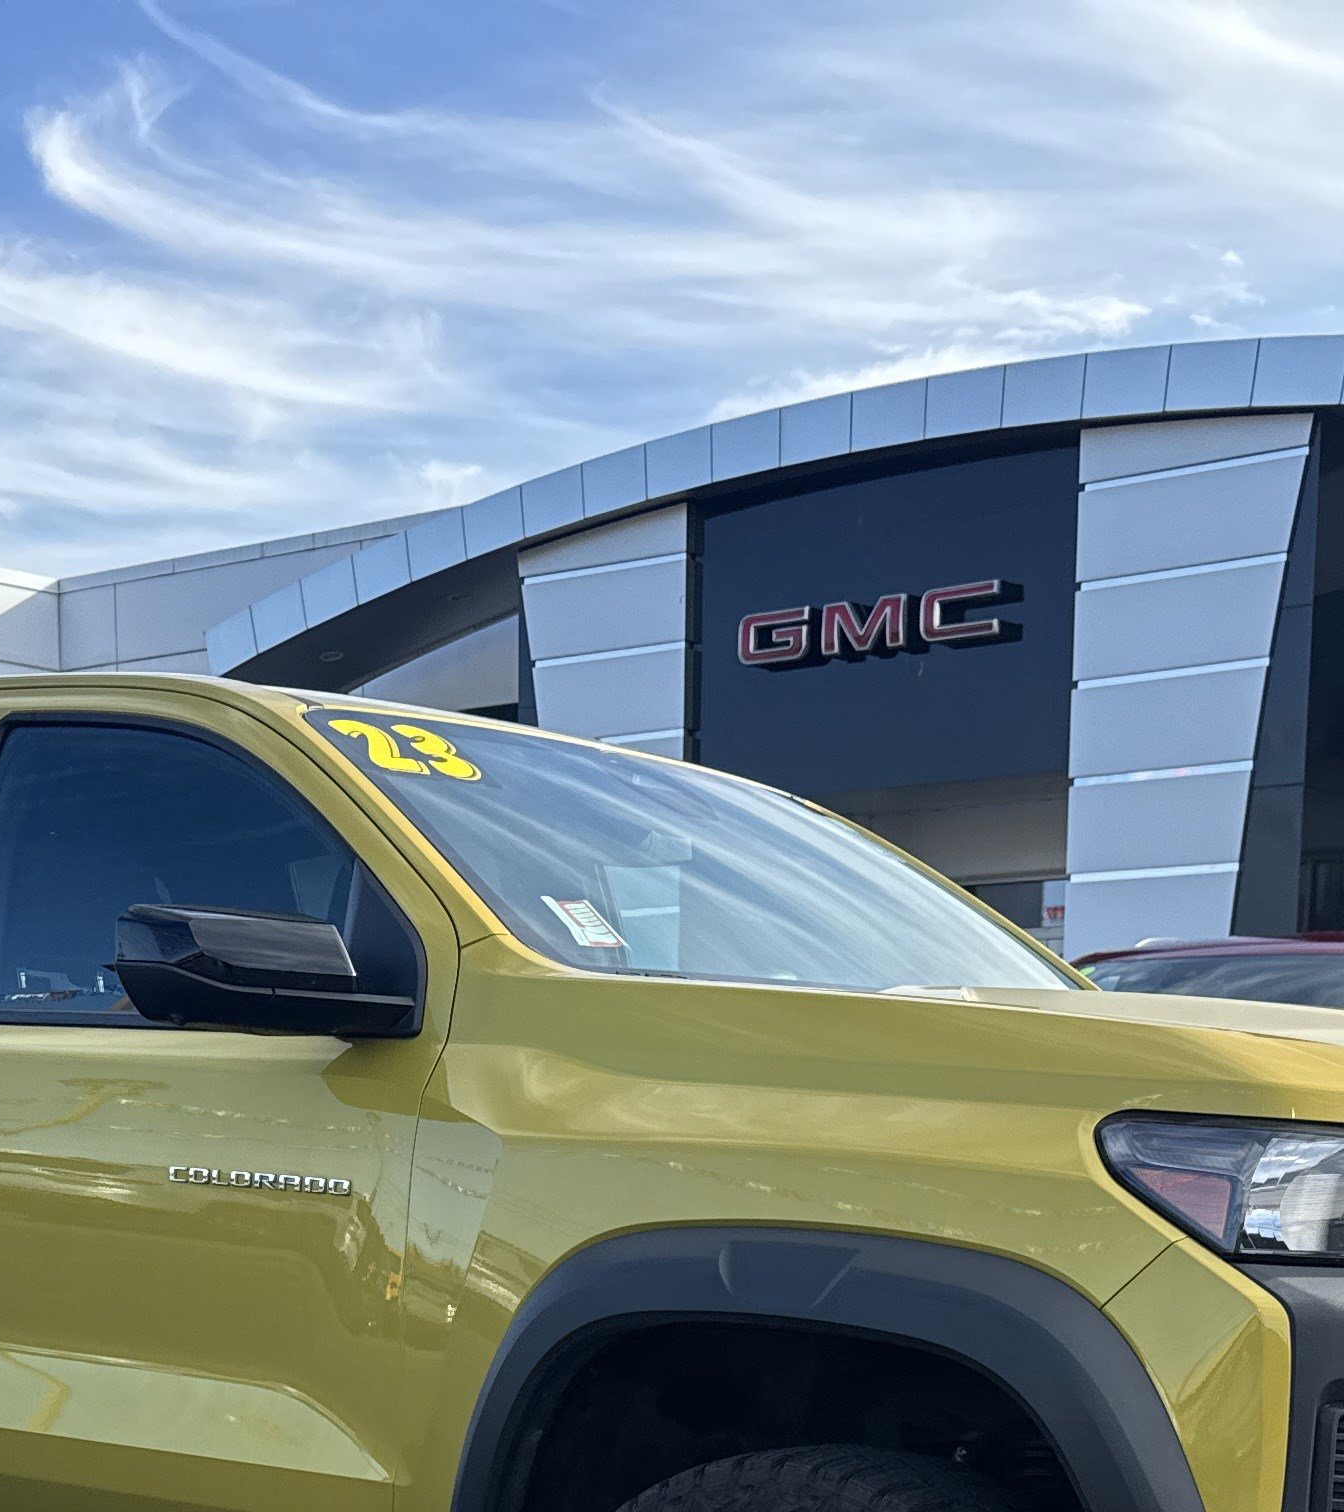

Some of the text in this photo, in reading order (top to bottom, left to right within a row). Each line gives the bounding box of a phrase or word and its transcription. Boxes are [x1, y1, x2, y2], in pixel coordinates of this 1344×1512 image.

[737, 579, 1002, 666] GMC
[327, 719, 482, 782] 23
[169, 1165, 352, 1196] COLORADO
